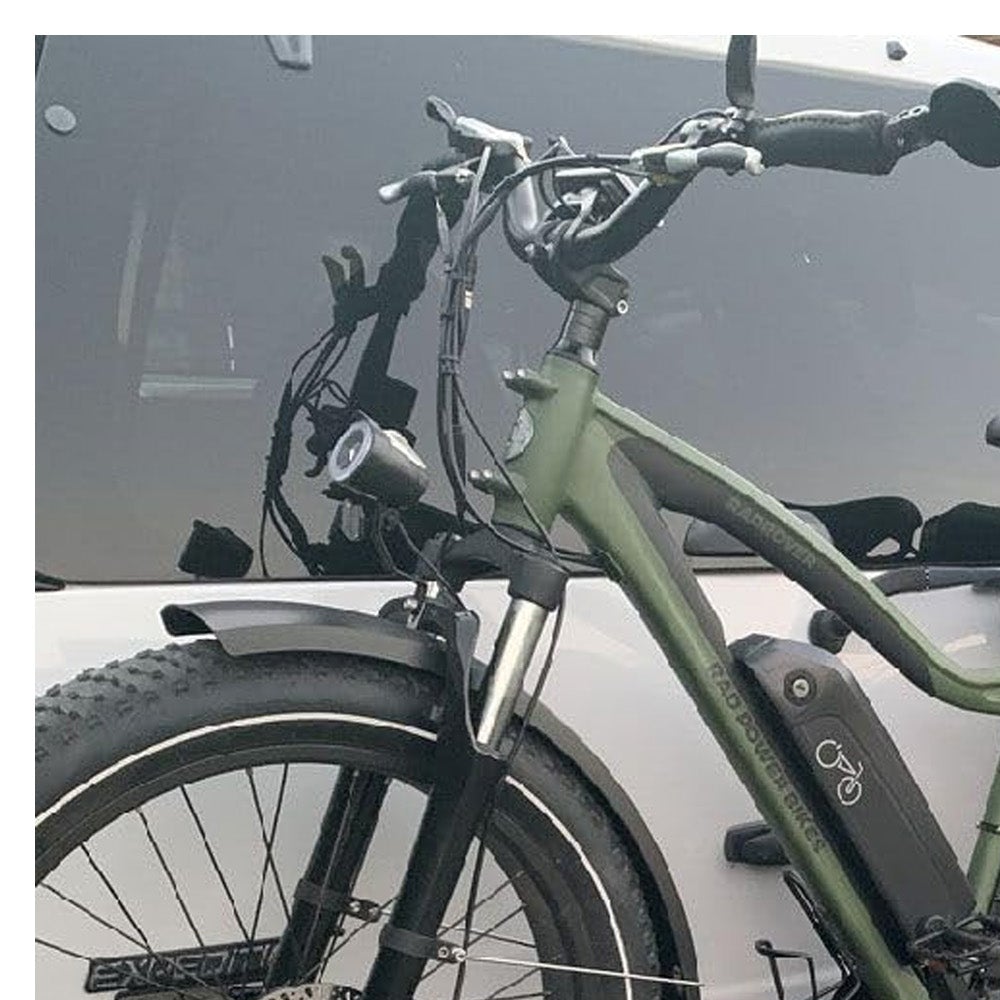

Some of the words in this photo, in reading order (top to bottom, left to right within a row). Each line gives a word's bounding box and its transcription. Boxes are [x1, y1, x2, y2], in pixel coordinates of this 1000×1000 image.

[712, 662, 741, 710] RAD
[736, 711, 785, 789] POWER
[783, 792, 827, 855] BIKES
